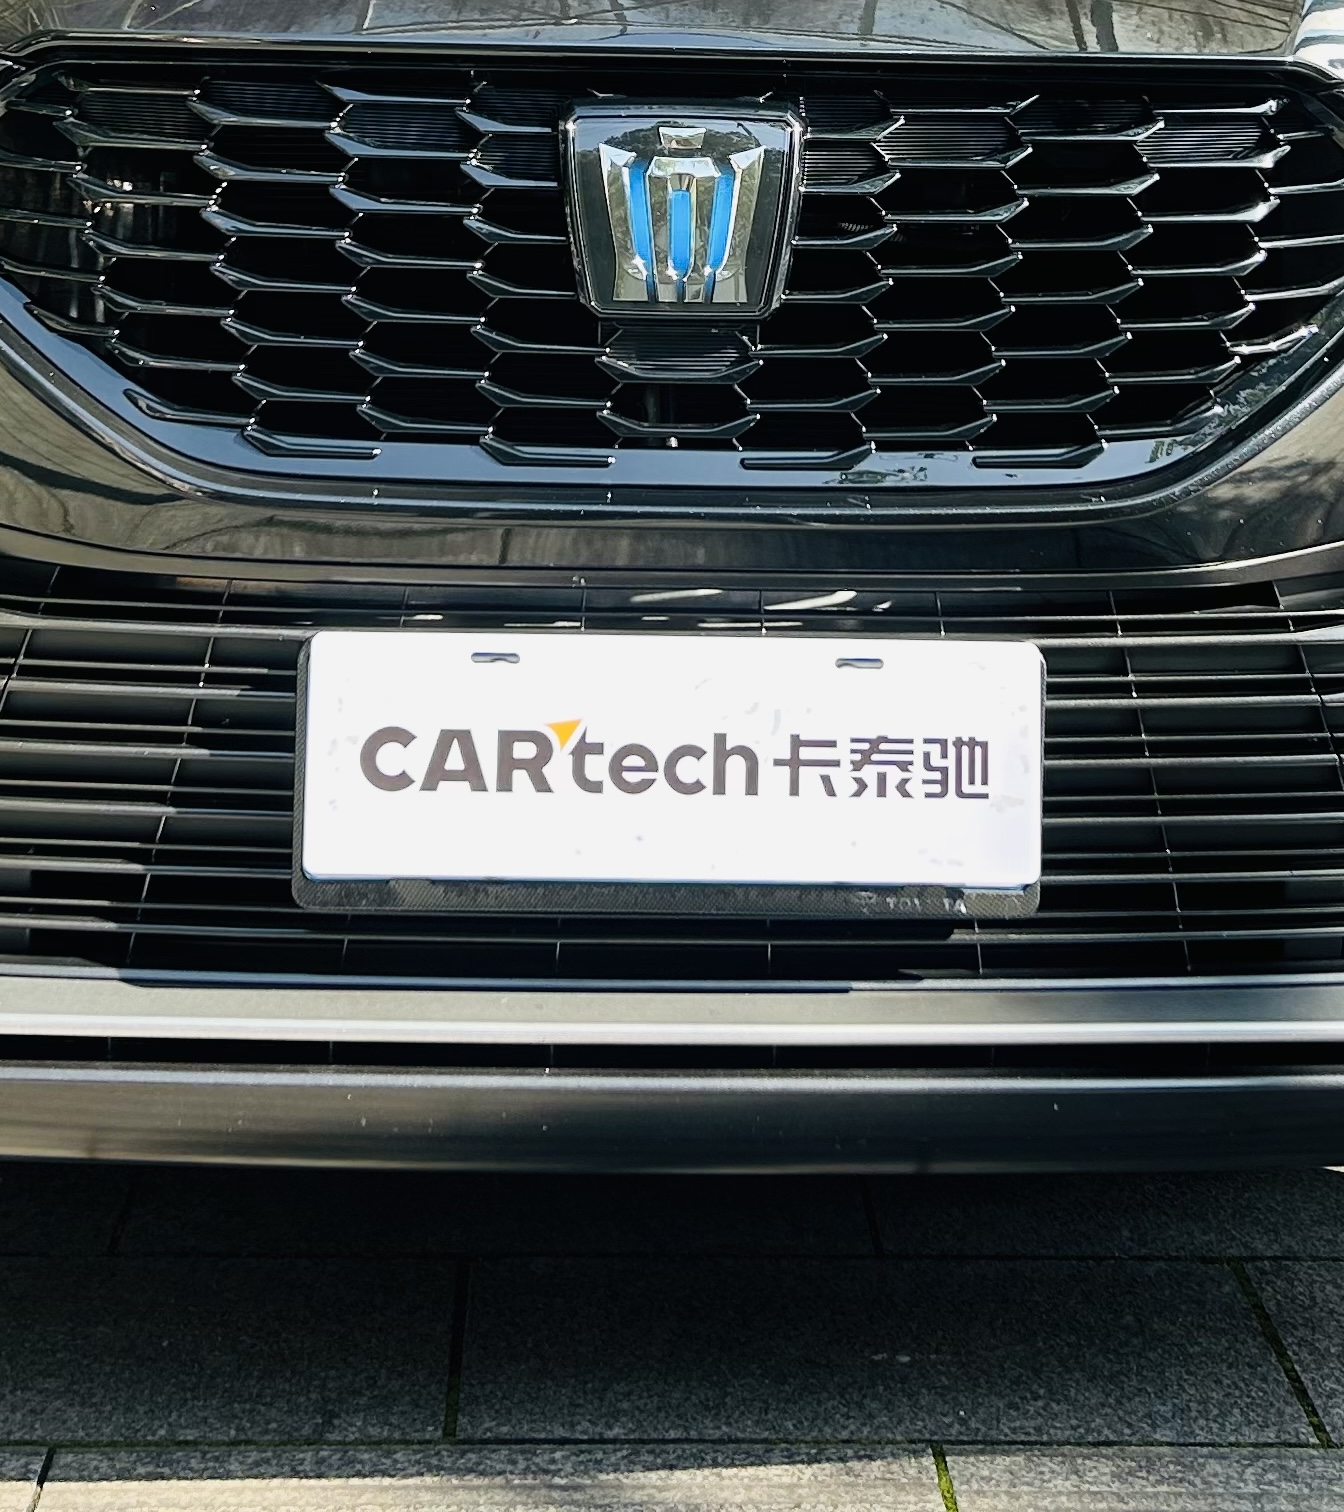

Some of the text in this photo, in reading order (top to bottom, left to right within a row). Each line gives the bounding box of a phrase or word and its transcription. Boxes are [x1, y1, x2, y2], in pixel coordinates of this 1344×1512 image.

[358, 719, 991, 800] CARtech 卡泰驰
